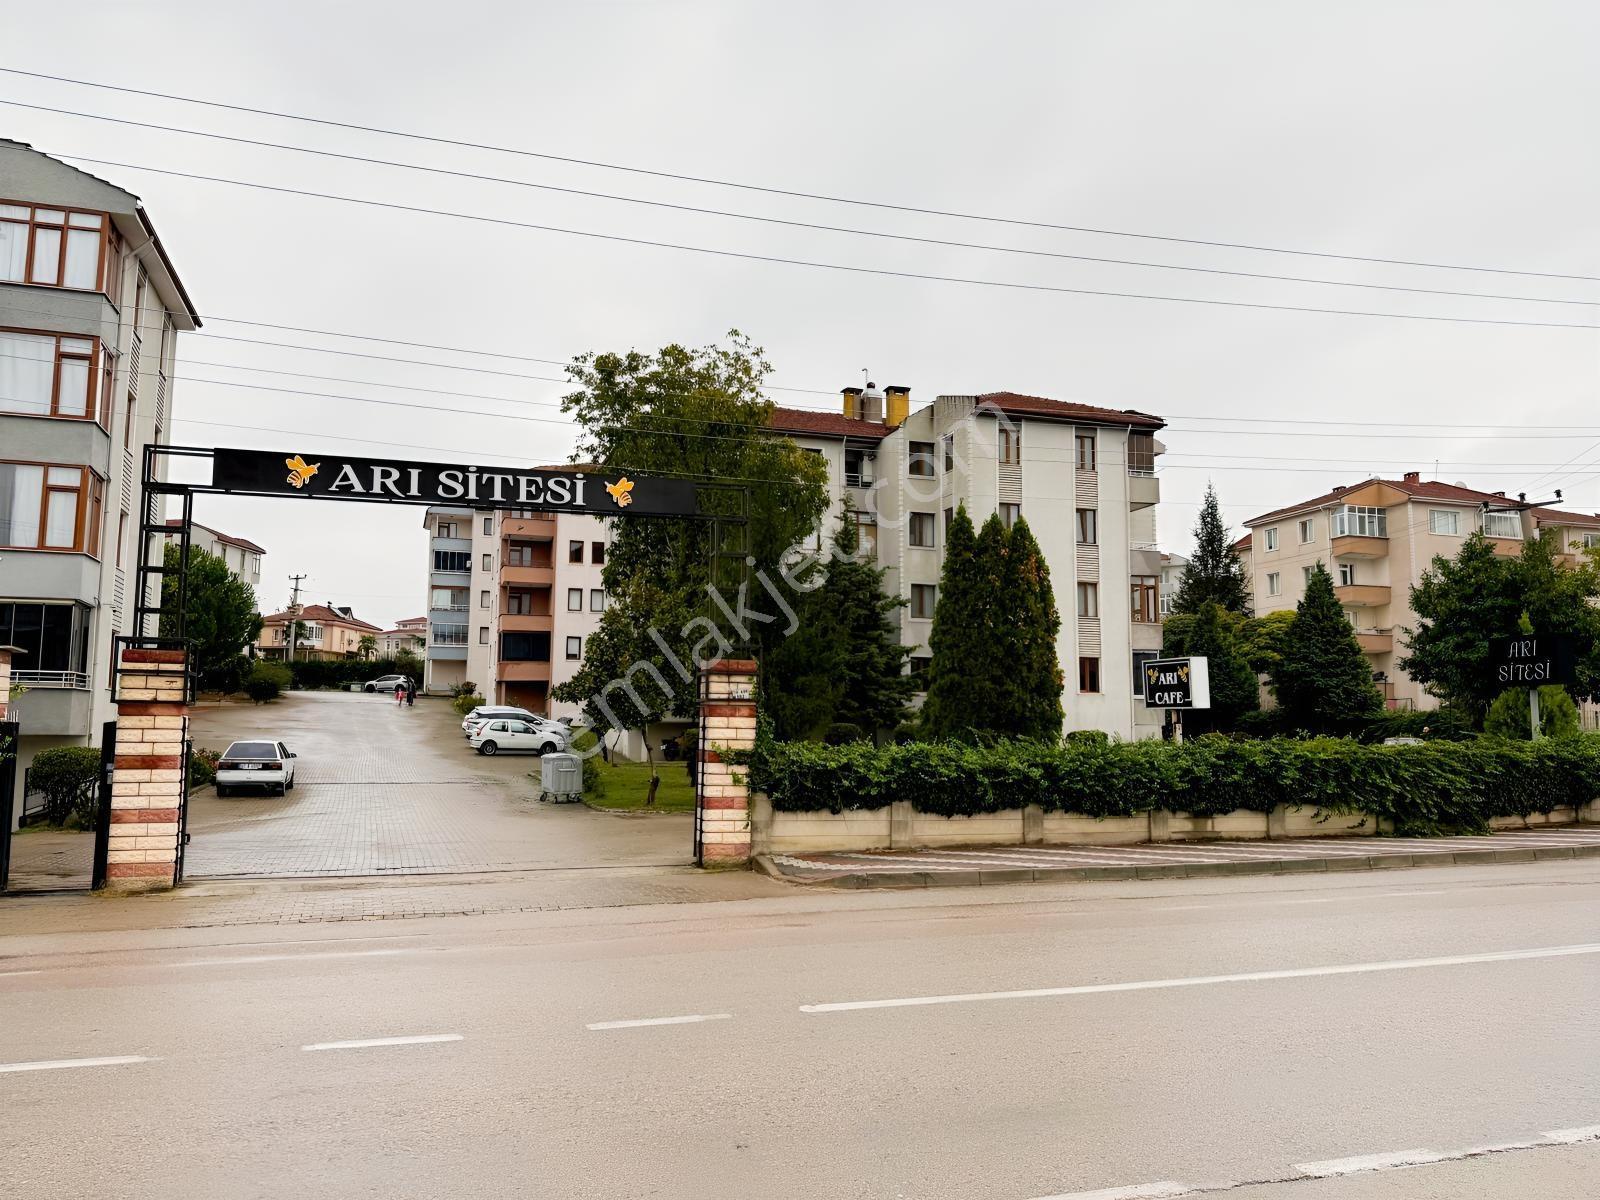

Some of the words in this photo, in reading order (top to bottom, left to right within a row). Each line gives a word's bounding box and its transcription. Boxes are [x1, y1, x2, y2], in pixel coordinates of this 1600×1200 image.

[328, 464, 422, 497] ARI
[437, 466, 587, 506] SİTESİ
[1508, 639, 1537, 658] ARI
[1158, 671, 1178, 685] ARI
[1498, 659, 1550, 681] SİTESİ
[1155, 691, 1184, 705] CAFE
